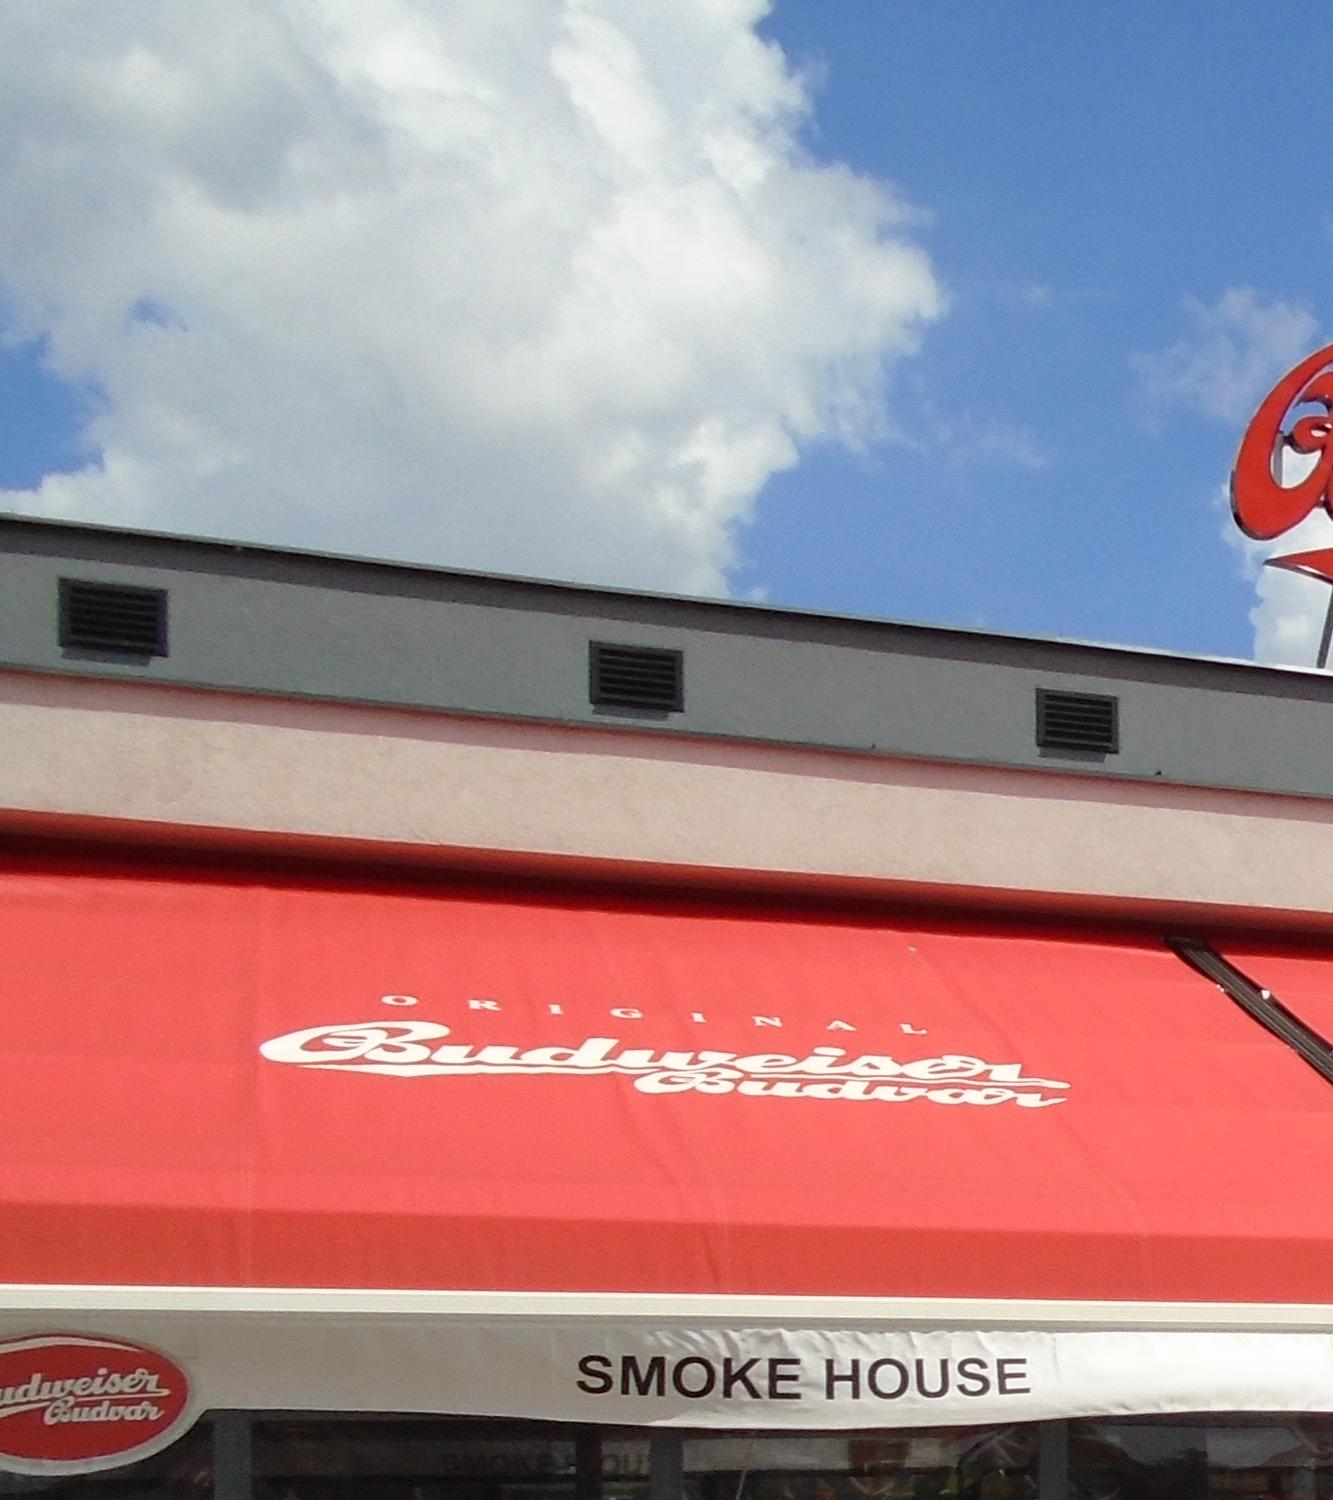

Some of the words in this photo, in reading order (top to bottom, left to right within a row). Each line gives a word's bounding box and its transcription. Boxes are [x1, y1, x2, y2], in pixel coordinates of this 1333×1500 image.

[381, 994, 928, 1036] ORIGINAL
[259, 1019, 1072, 1089] Budweiser
[634, 1068, 1067, 1108] Budvar
[0, 1367, 170, 1409] udweiser
[576, 1355, 801, 1400] SMOKE
[825, 1357, 1031, 1400] HOUSE
[43, 1396, 165, 1426] Budvar
